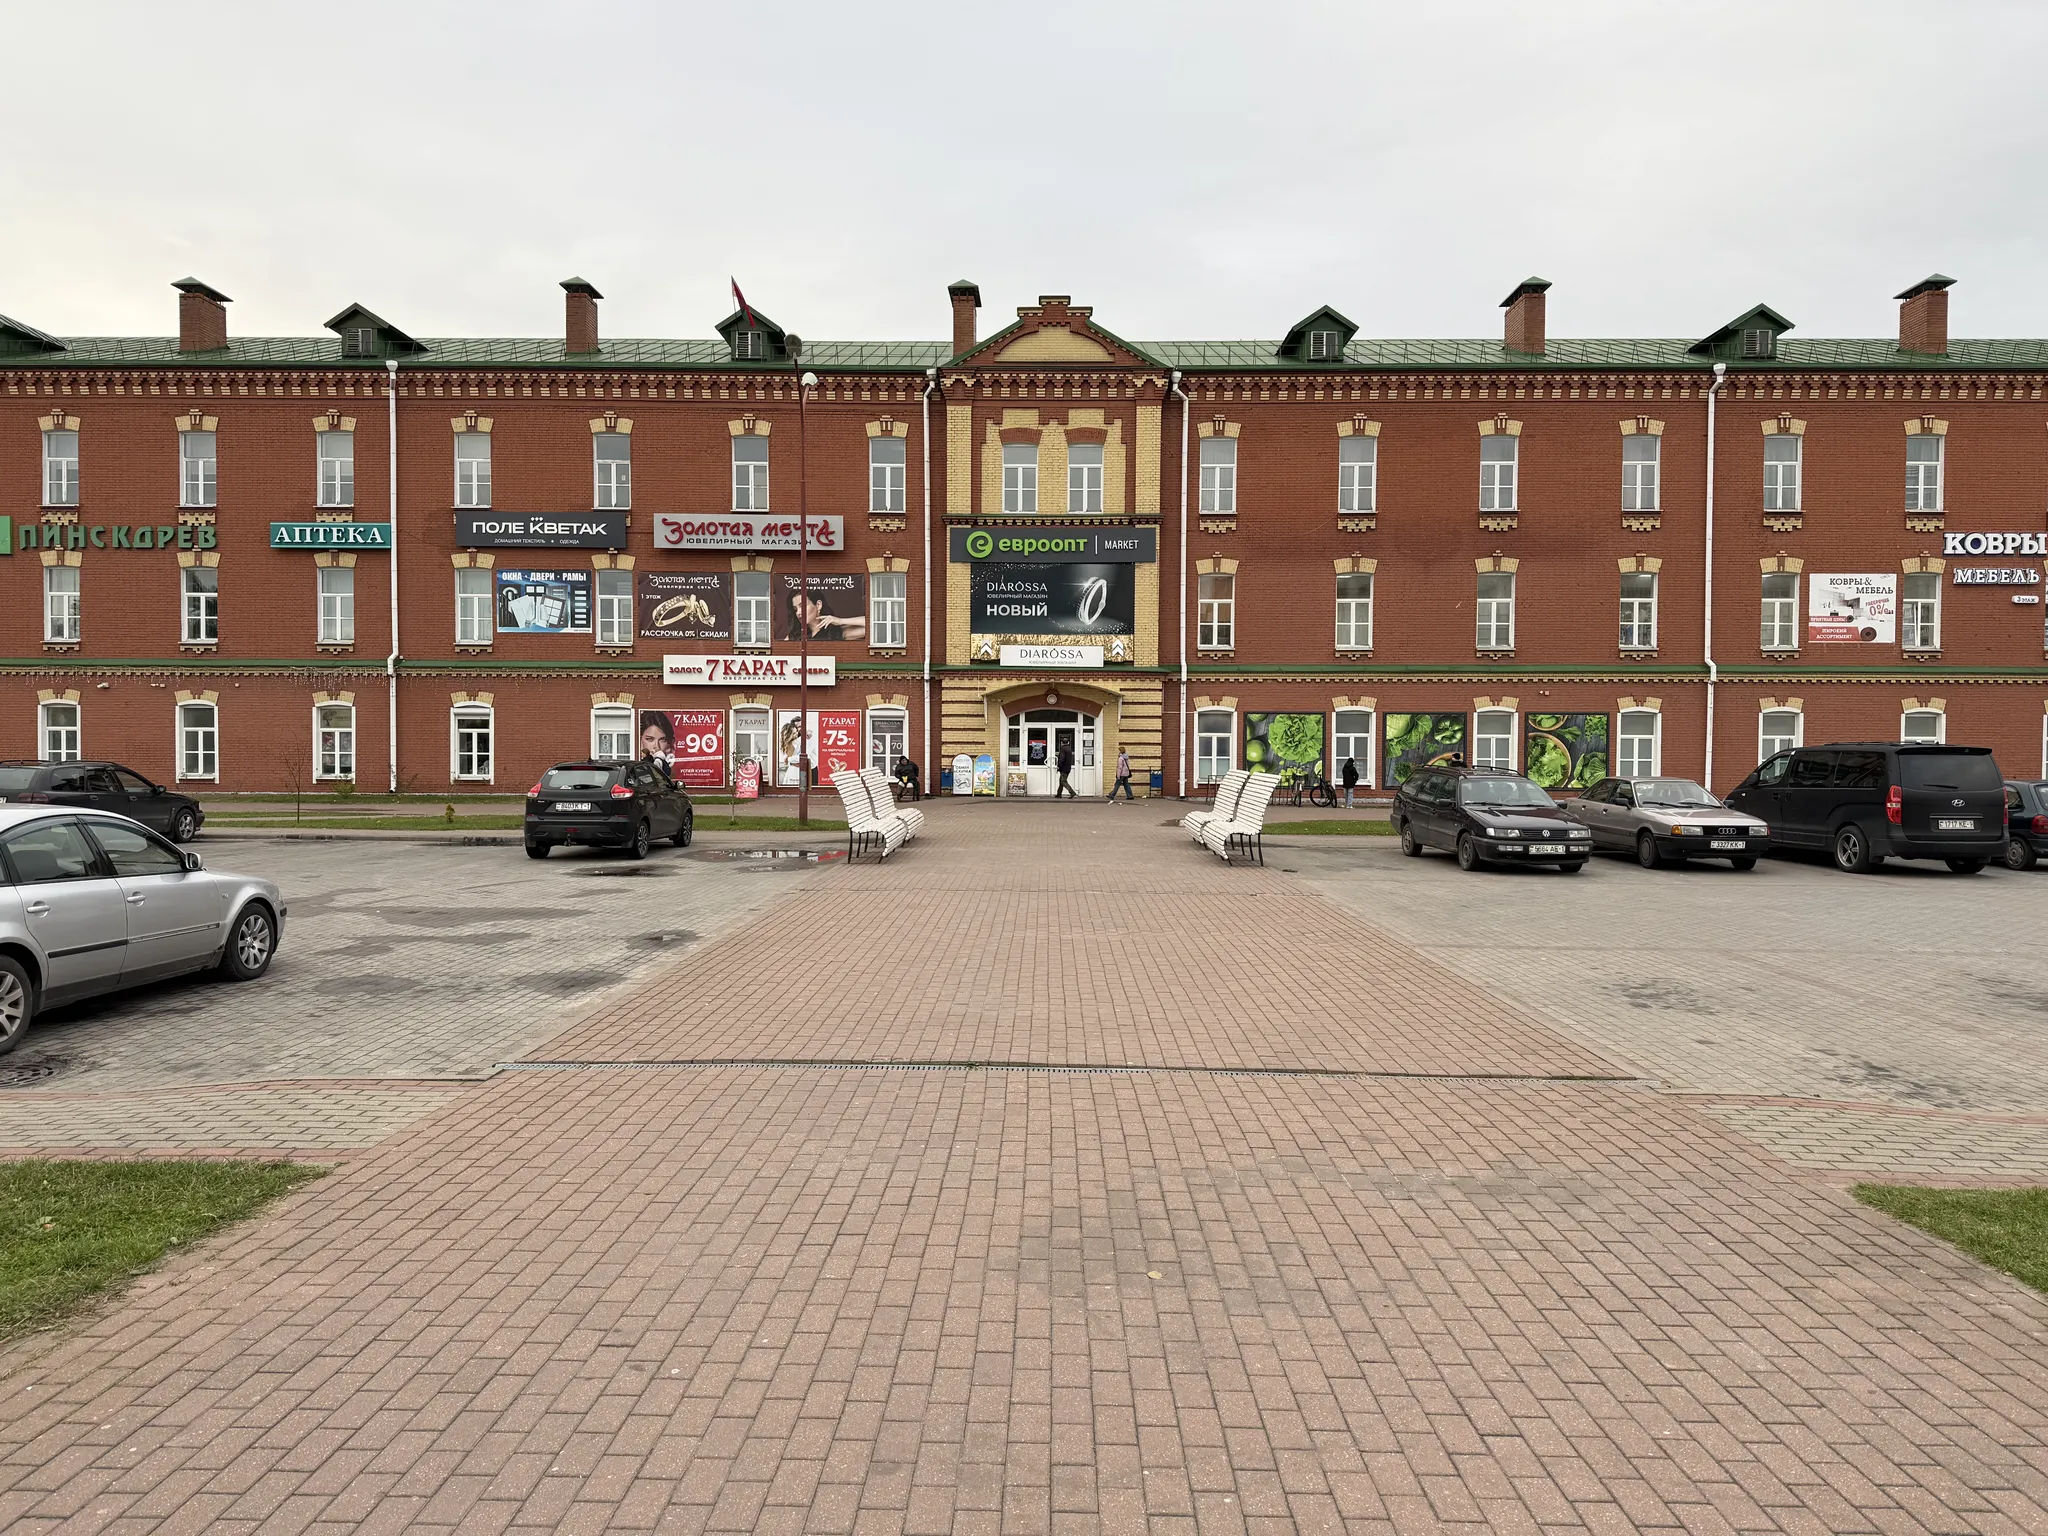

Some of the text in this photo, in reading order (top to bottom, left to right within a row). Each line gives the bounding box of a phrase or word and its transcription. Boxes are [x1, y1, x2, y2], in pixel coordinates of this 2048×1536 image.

[473, 519, 607, 535] ПОЛЕ КВЕТАК
[19, 525, 218, 550] ПИНСКДРЕВ
[275, 527, 385, 543] АПТЕКА
[687, 538, 753, 546] ЮВЕЛИРНЫЙ
[998, 538, 1139, 556] евроопт MARKET
[1943, 532, 2048, 555] КОВРЫ
[502, 572, 587, 582] ОКНА ДВЕРИ РАМЫ
[1830, 577, 1862, 586] КОВРЫ
[1864, 577, 1872, 585] &
[1955, 568, 2040, 584] МЕБЕЛЬ
[986, 602, 1048, 616] НОВЫЙ
[641, 630, 683, 638] РАССРОЧКА
[706, 659, 721, 682] 7
[722, 659, 788, 677] КАРАТ
[674, 714, 717, 726] 7 КАРАТ
[739, 719, 744, 727] 7
[822, 718, 829, 728] 7
